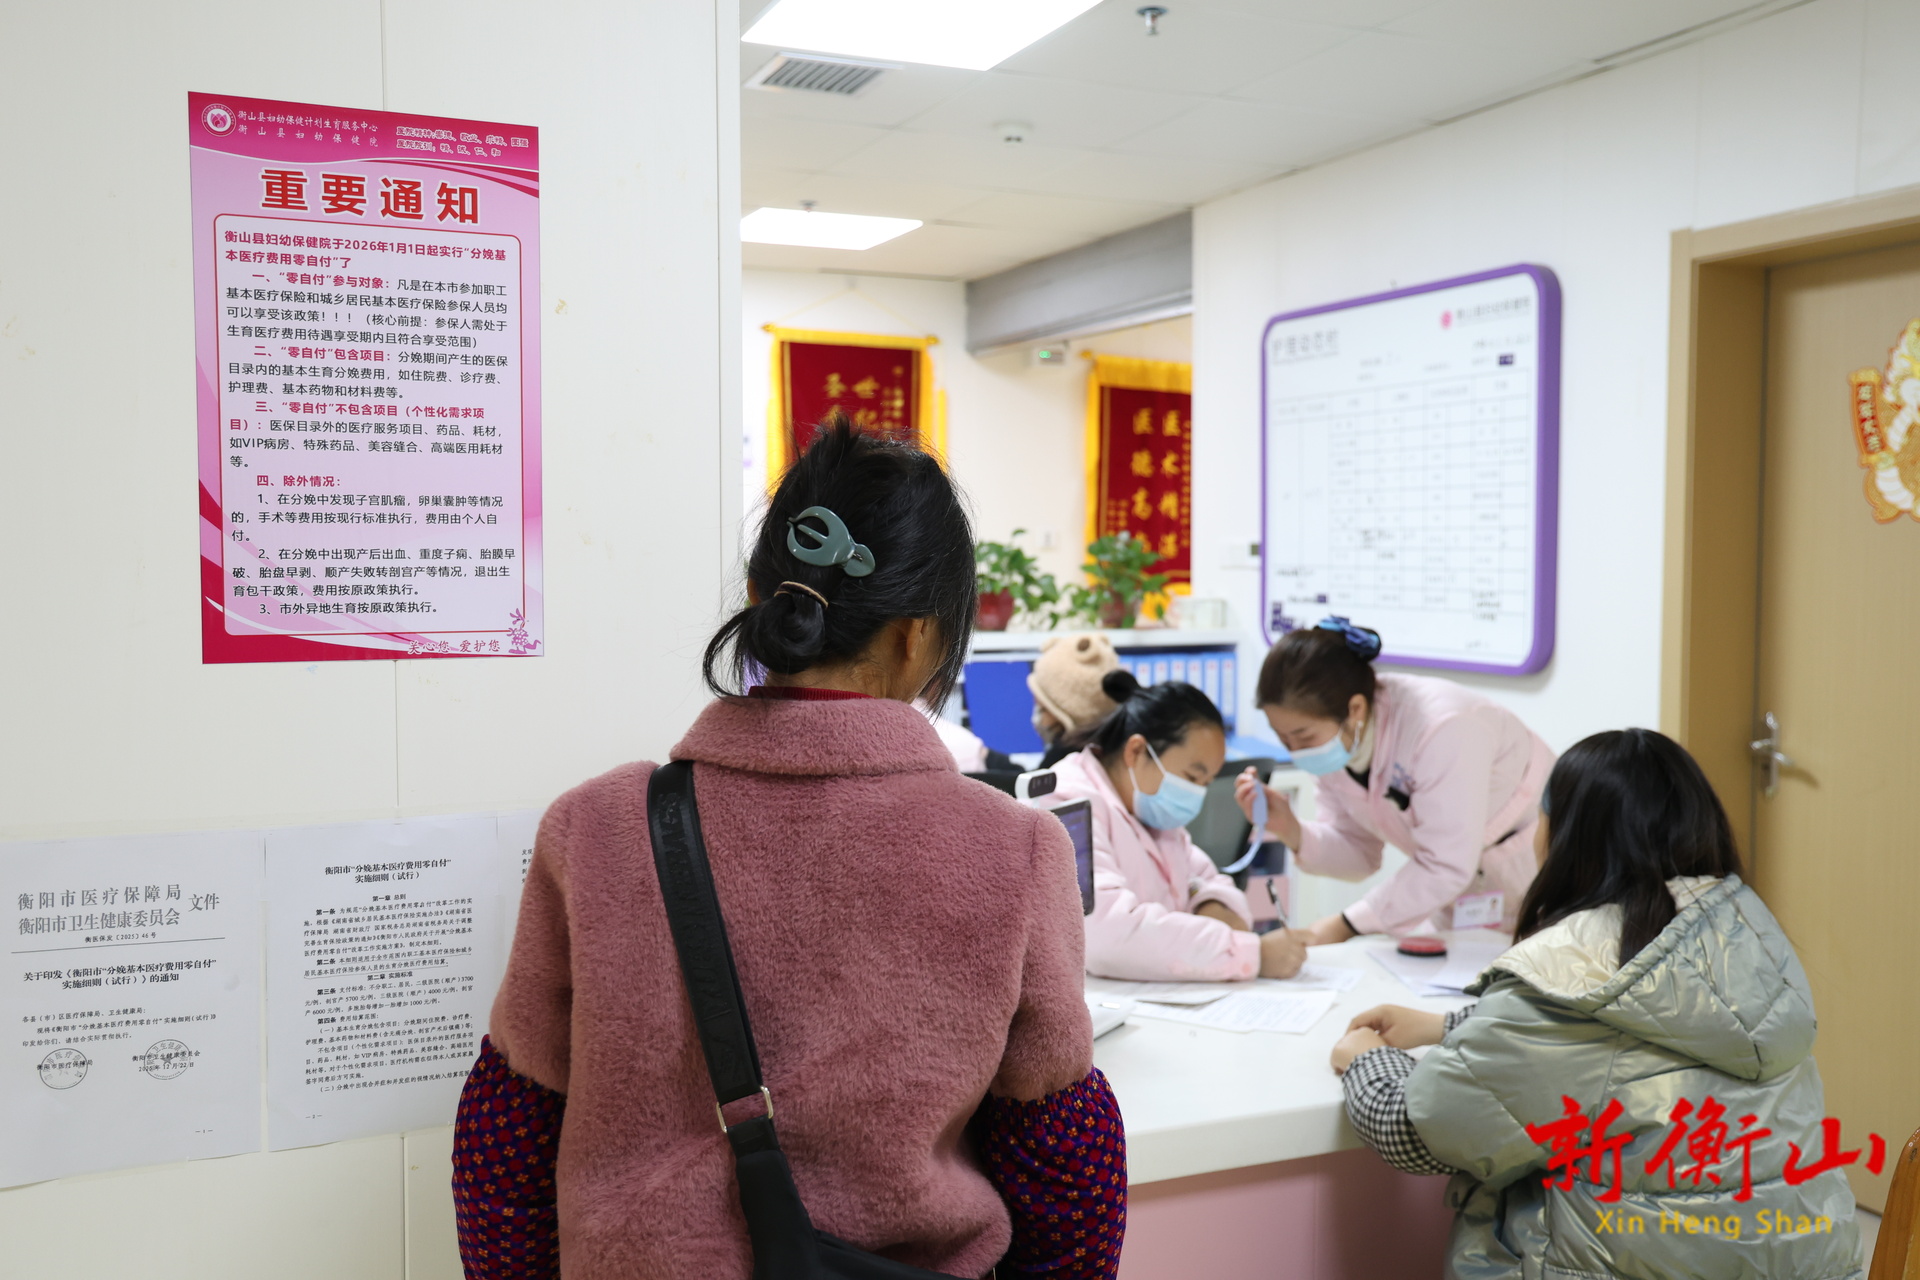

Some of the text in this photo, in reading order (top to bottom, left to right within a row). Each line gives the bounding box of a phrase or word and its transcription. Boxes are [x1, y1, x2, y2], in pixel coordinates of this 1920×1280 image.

[238, 110, 378, 133] 衡山县妇幼保健计划生育服务中心
[238, 125, 378, 147] 衡山县妇幼保健院
[259, 167, 481, 226] 重要通知
[226, 287, 507, 314] 基本医疗保险和城乡居民基本医疗保险参保人员均
[227, 325, 476, 348] 生育医疗费用待遇享受期内且符合享受范围）
[229, 363, 500, 384] 目录内的基本生育分娩费用，如住院费、诊疗费、
[228, 381, 403, 398] 护理费、基本药物和材料费等。
[229, 437, 503, 454] 如VIP病房、特殊药品、美容缝合、高端医用耗材
[230, 455, 248, 467] 等。
[257, 475, 340, 487] 四、除外情况：
[231, 512, 497, 524] 的，手术等费用按现行标准执行，费用由个人自
[232, 530, 252, 544] 付。
[233, 566, 510, 578] 破、胎盘早剥、顺产失败转剖宫产等情况，退出生
[233, 584, 418, 599] 育包干政策，费用按原政策执行。
[260, 601, 437, 616] 3、市外异地生育按原政策执行。
[459, 639, 501, 653] 爱护您
[355, 872, 419, 883] 实施细则（试行）
[18, 884, 220, 912] 衡阳市医疗保障局 文件
[19, 908, 180, 935] 衡阳市卫生健康委员会
[62, 973, 179, 990] 实施细则（试行）》的通知
